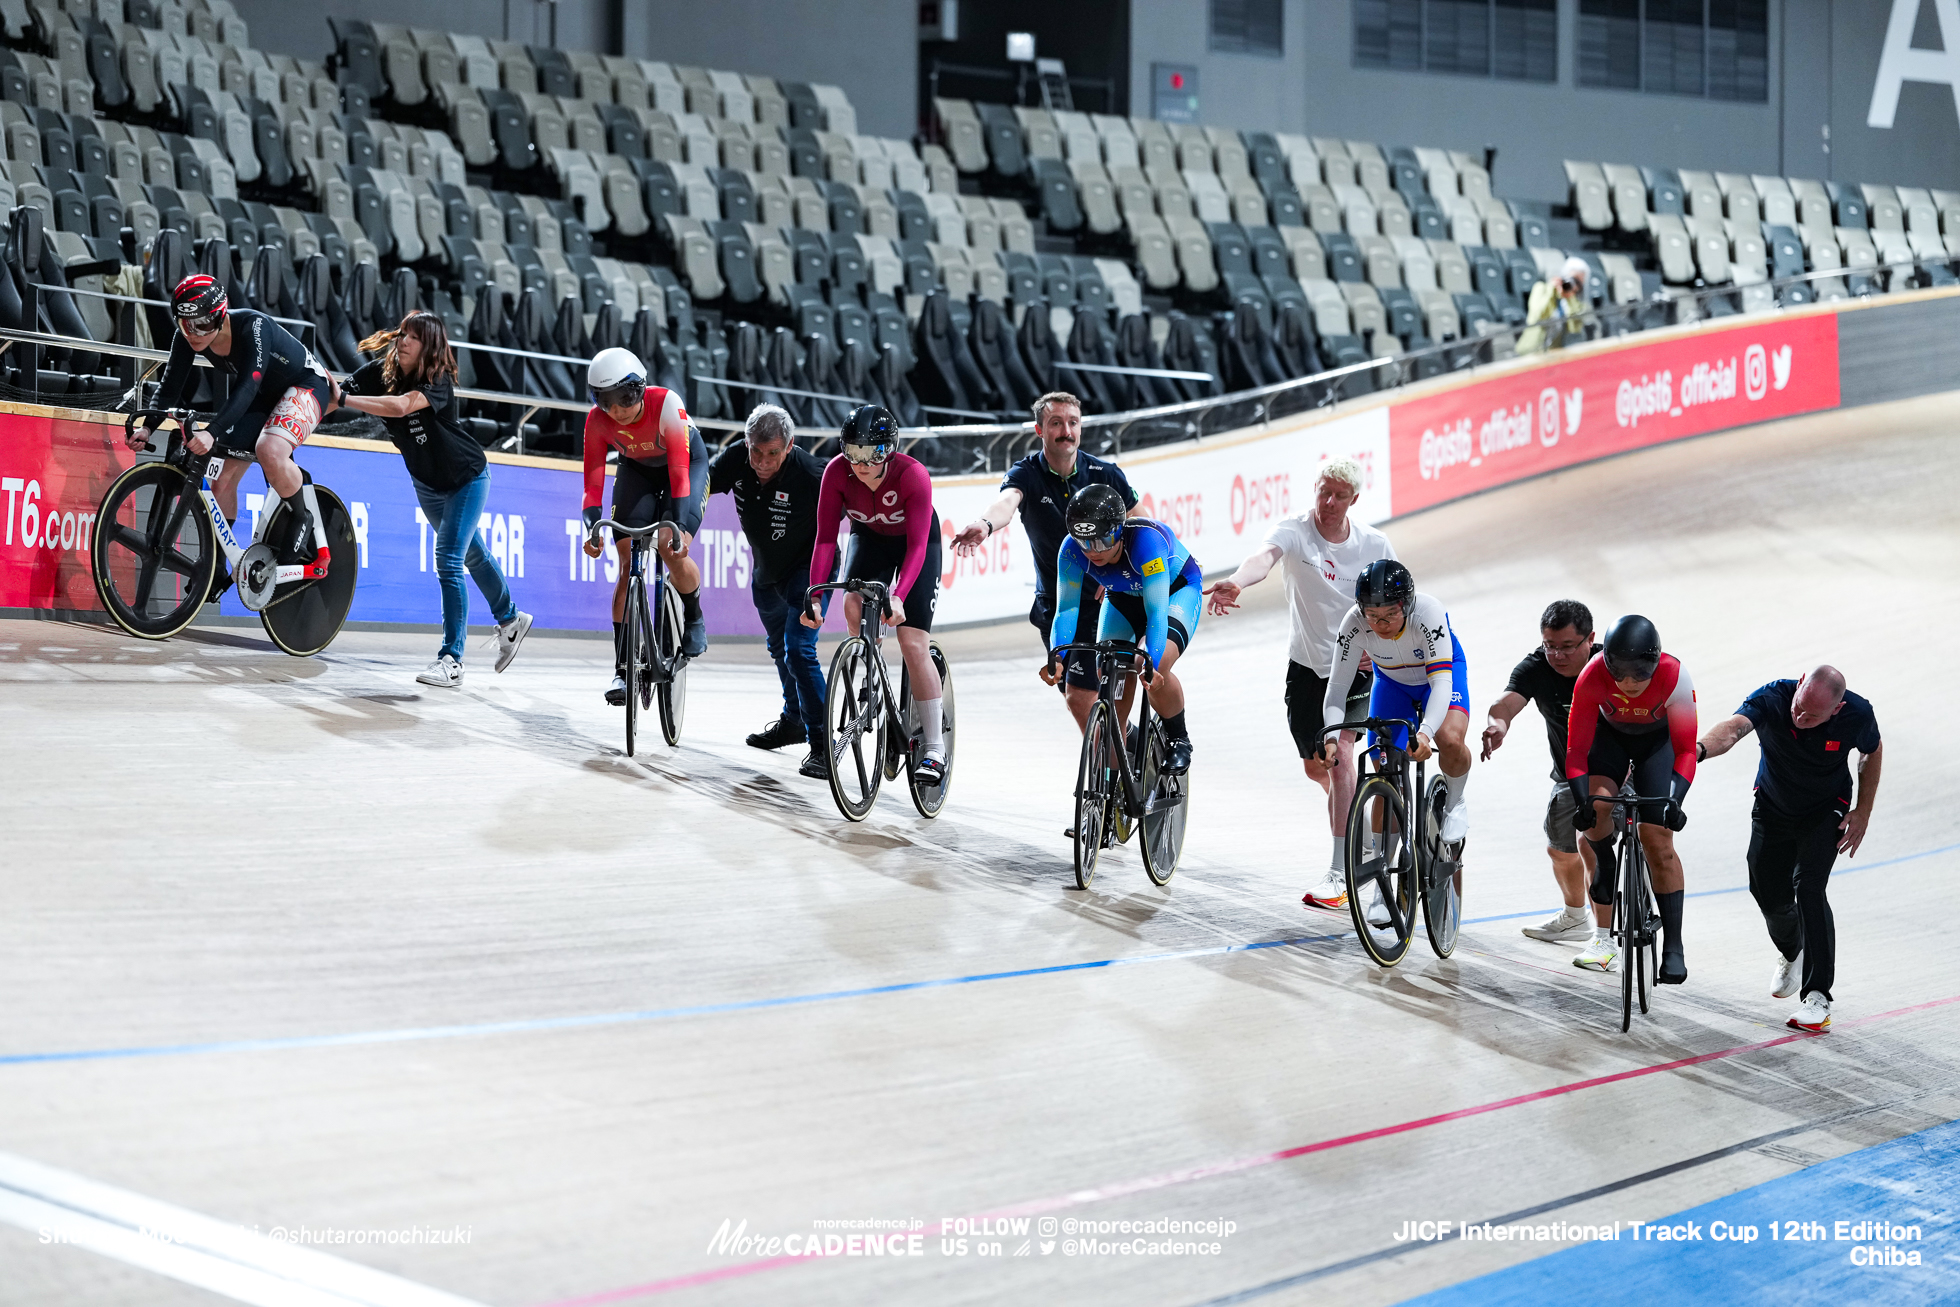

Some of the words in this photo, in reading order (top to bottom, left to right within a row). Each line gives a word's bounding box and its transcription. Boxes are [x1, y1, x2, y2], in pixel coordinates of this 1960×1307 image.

[1866, 0, 1960, 130] A
[1615, 356, 1737, 428] @pist6_official
[1418, 402, 1532, 481] @pist6_official
[1248, 473, 1290, 523] PIST6
[279, 570, 302, 578] JAPAN
[1341, 626, 1360, 662] TROXUS
[1420, 622, 1437, 658] TROXUS
